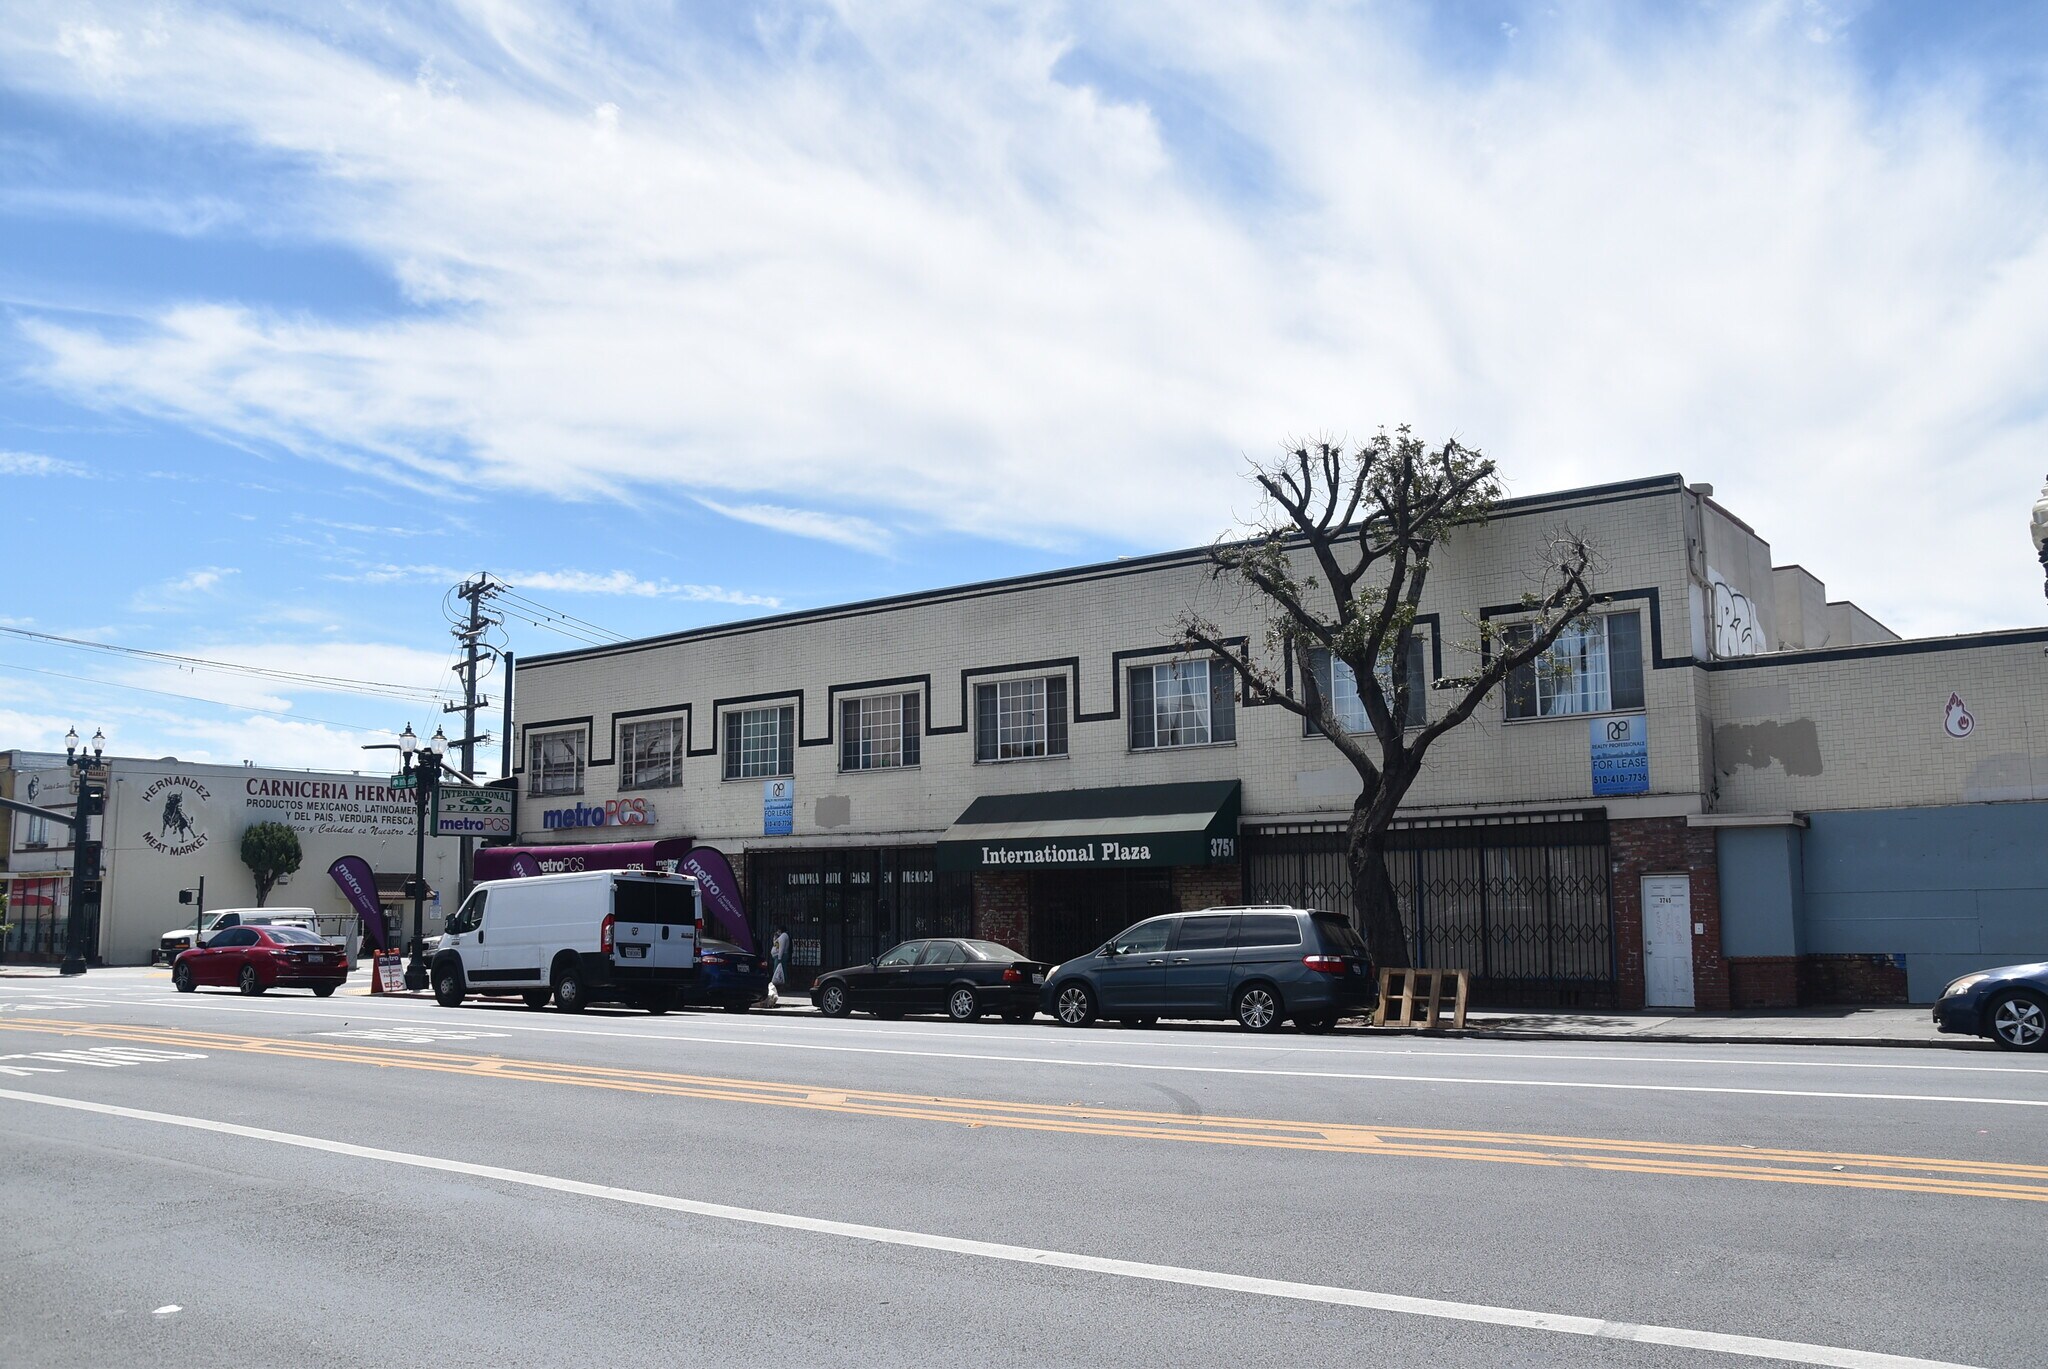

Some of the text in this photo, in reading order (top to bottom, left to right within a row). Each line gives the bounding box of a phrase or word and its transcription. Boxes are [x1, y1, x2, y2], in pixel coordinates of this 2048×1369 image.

[1593, 757, 1646, 770] FOR LEASE
[1593, 773, 1647, 784] 510-410-7736
[142, 776, 211, 802] HERNANDEZ
[246, 778, 348, 800] CARNICERIA
[441, 789, 510, 802] INTERNATIONAL
[246, 799, 303, 810] PRODUCTOS
[307, 803, 362, 813] MEXICANOS,
[446, 804, 505, 812] PLAZA
[543, 797, 647, 829] metroPCS
[777, 809, 792, 817] LEASE
[286, 812, 291, 820] Y
[294, 812, 311, 821] DEL
[339, 813, 378, 823] VERDURA
[440, 817, 510, 832] metroPCS
[308, 826, 315, 834] y
[318, 823, 354, 834] Calidad
[370, 825, 404, 836] Nuestro
[407, 828, 430, 836] Lea
[142, 831, 208, 856] MEAT MARKET
[1210, 838, 1234, 858] 3751
[982, 842, 1151, 864] International Plaza
[538, 857, 585, 873] etroPCS
[338, 864, 362, 895] metro
[687, 858, 720, 895] metro
[717, 897, 731, 912] Dealer
[721, 895, 742, 918] Authorized
